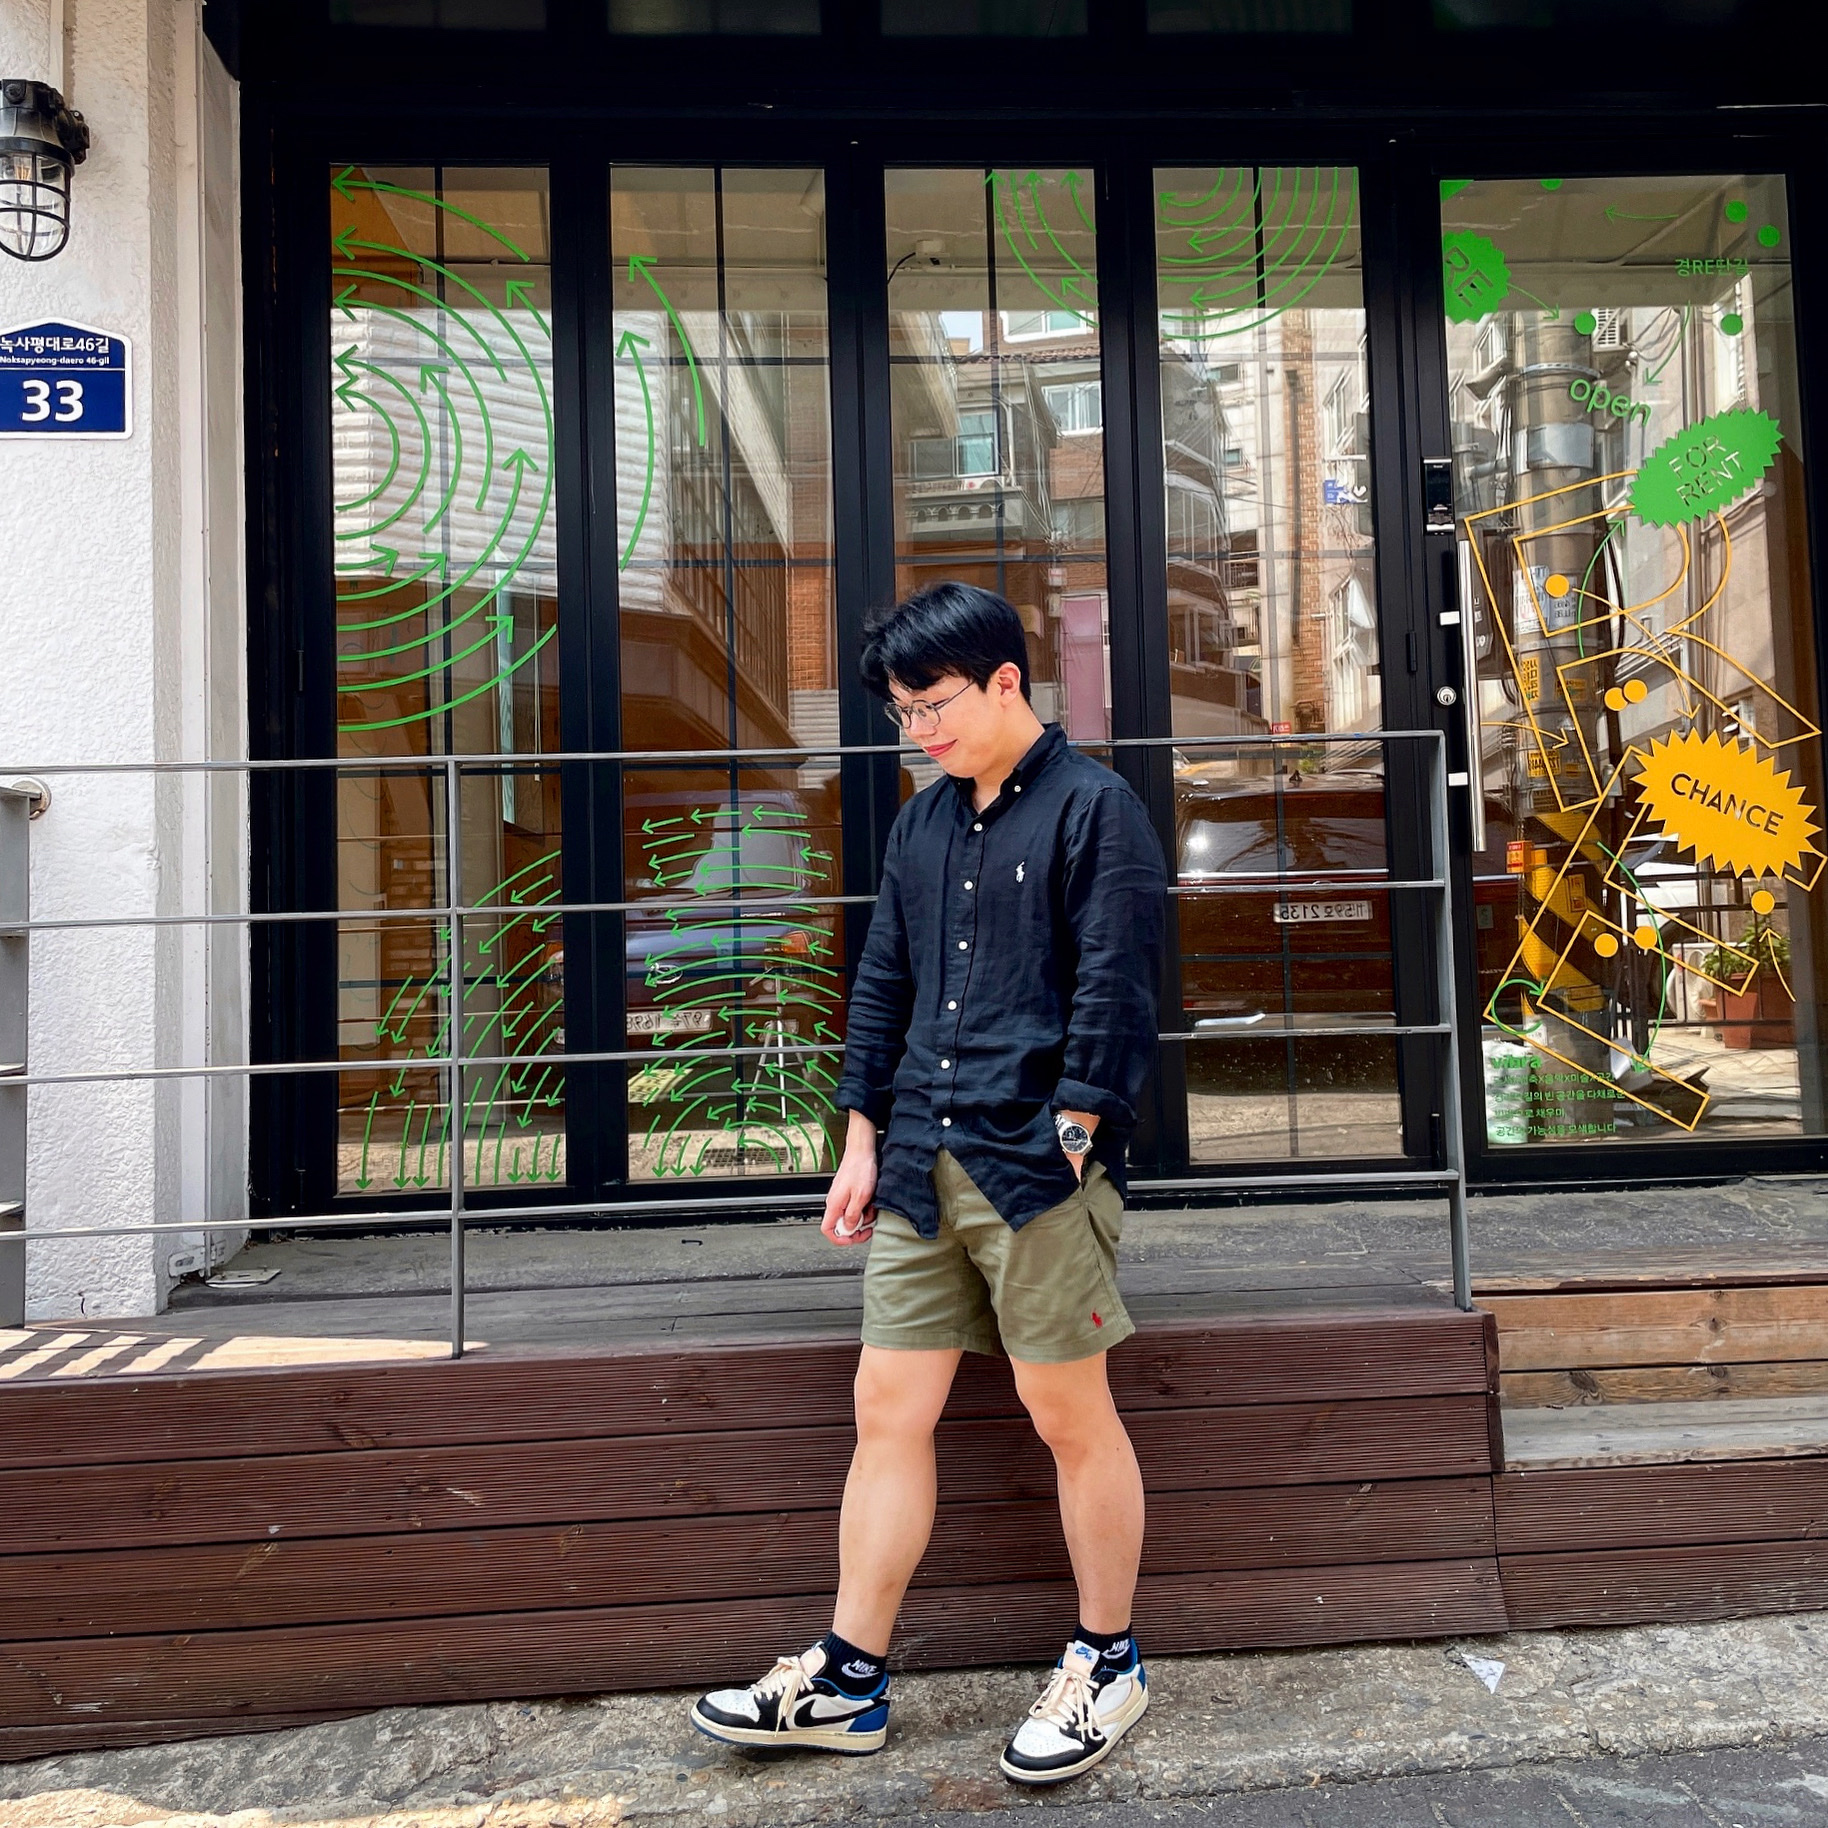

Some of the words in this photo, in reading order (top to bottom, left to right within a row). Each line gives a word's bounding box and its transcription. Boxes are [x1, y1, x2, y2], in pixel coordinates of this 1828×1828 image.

[0, 336, 110, 354] 녹사평대로46길
[0, 356, 84, 366] Noksapyeong-daero
[86, 356, 110, 366] 46-gil
[21, 379, 84, 422] 33
[1569, 378, 1652, 427] open
[1669, 434, 1727, 479] FOR
[1675, 450, 1745, 507] RENT
[1670, 773, 1785, 836] CHANCE
